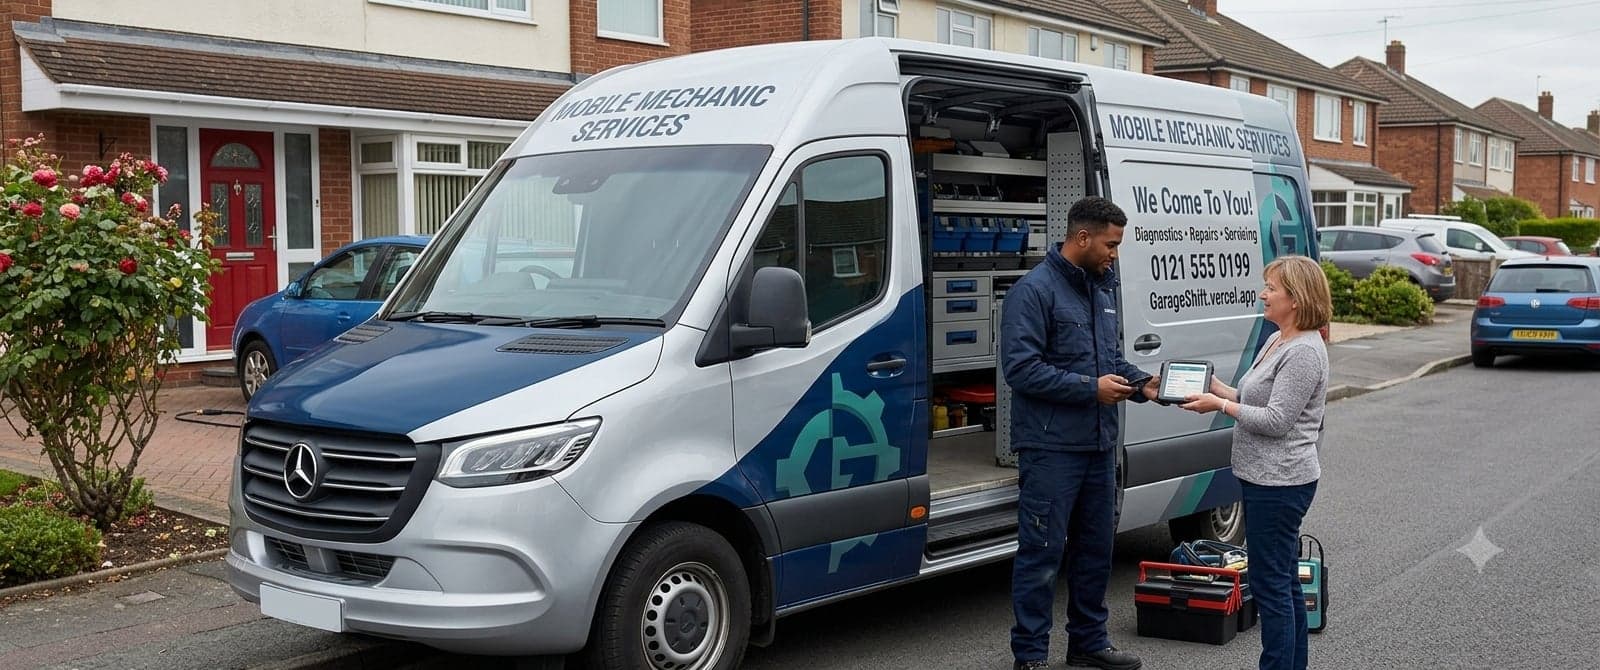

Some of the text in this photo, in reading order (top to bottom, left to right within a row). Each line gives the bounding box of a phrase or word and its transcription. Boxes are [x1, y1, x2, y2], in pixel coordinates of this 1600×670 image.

[550, 85, 776, 122] MOBILE MECHANIC
[571, 113, 690, 143] SERVICES
[1109, 114, 1291, 158] MOBILE MECHANIC SERVICES
[1132, 186, 1254, 216] We Come To You!
[1135, 226, 1183, 245] Diagnostics
[1189, 226, 1219, 245] Repairs
[1151, 252, 1250, 281] 0121 555 0199
[1149, 286, 1257, 313] GarageShift.vercel.app
